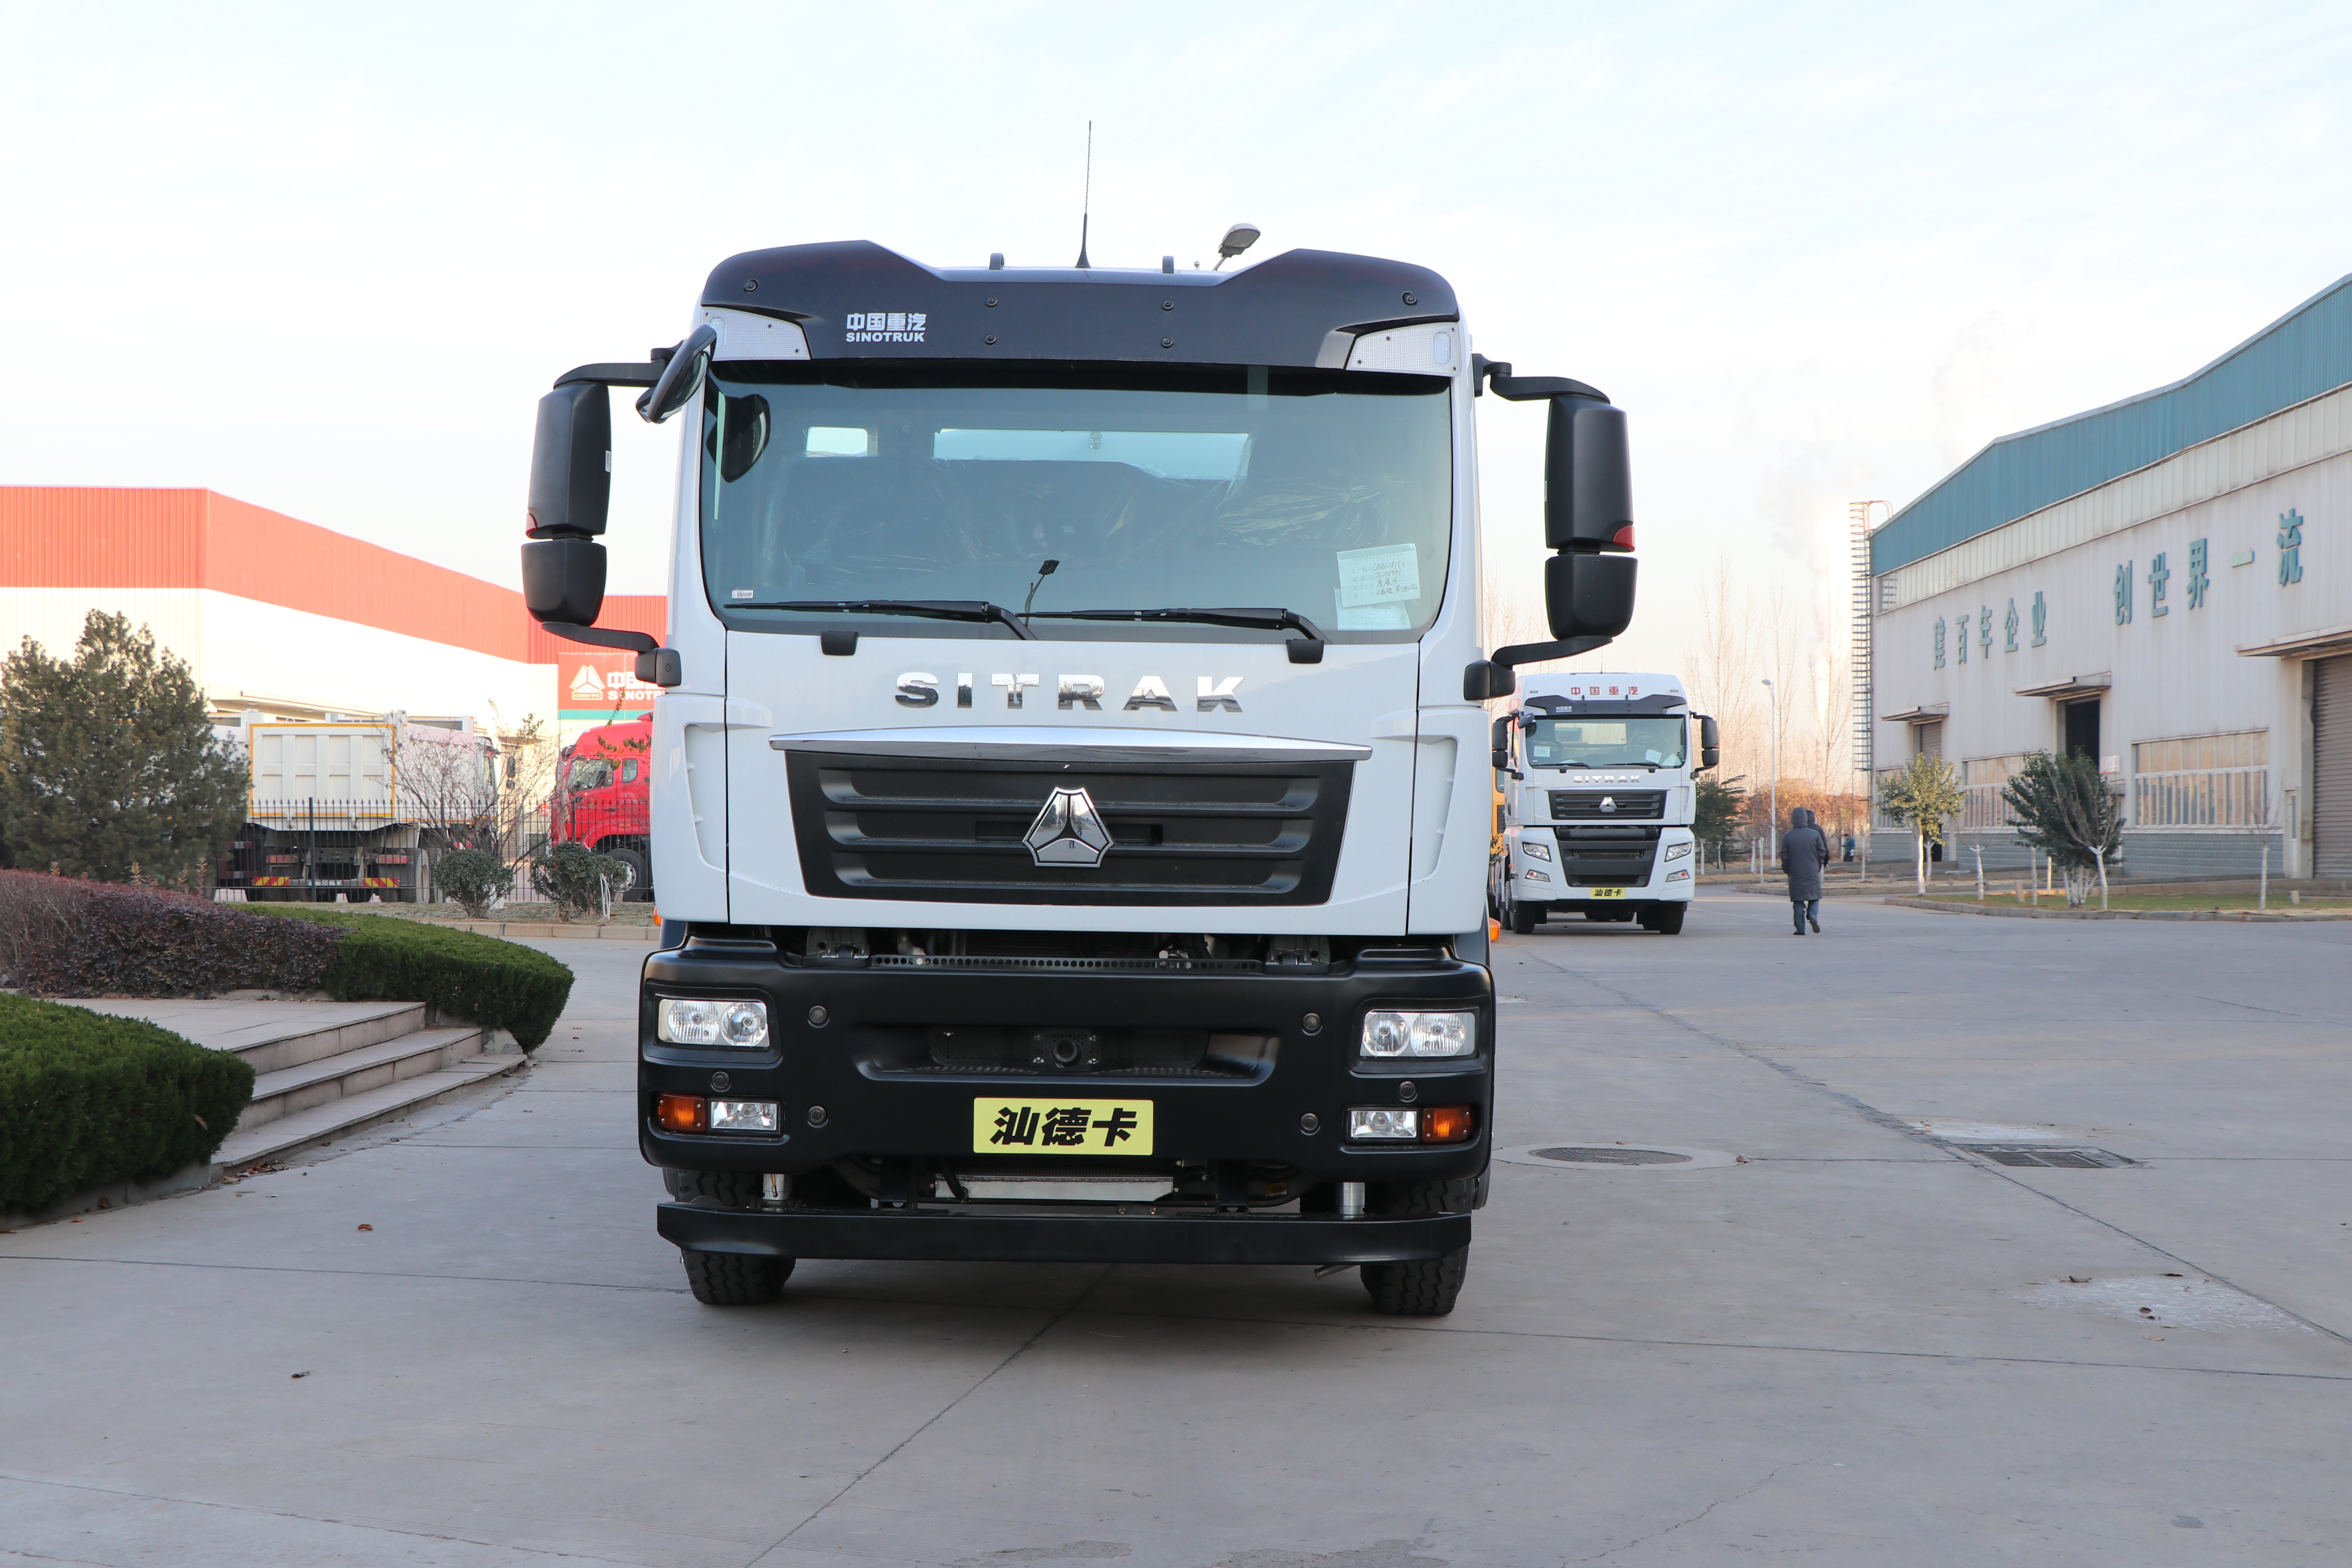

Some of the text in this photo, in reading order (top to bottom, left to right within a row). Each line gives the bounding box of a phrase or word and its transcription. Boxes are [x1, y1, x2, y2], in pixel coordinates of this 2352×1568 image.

[846, 312, 927, 331] 中国重汽
[845, 332, 925, 342] SINOTRUK
[1933, 508, 2304, 670] 建百年企业 创世界一流
[607, 671, 665, 689] 中国
[894, 671, 1246, 713] SITRAK
[1571, 686, 1638, 695] 中国重汽
[1594, 888, 1622, 897] 汕德卡
[989, 1106, 1138, 1146] 汕德卡
